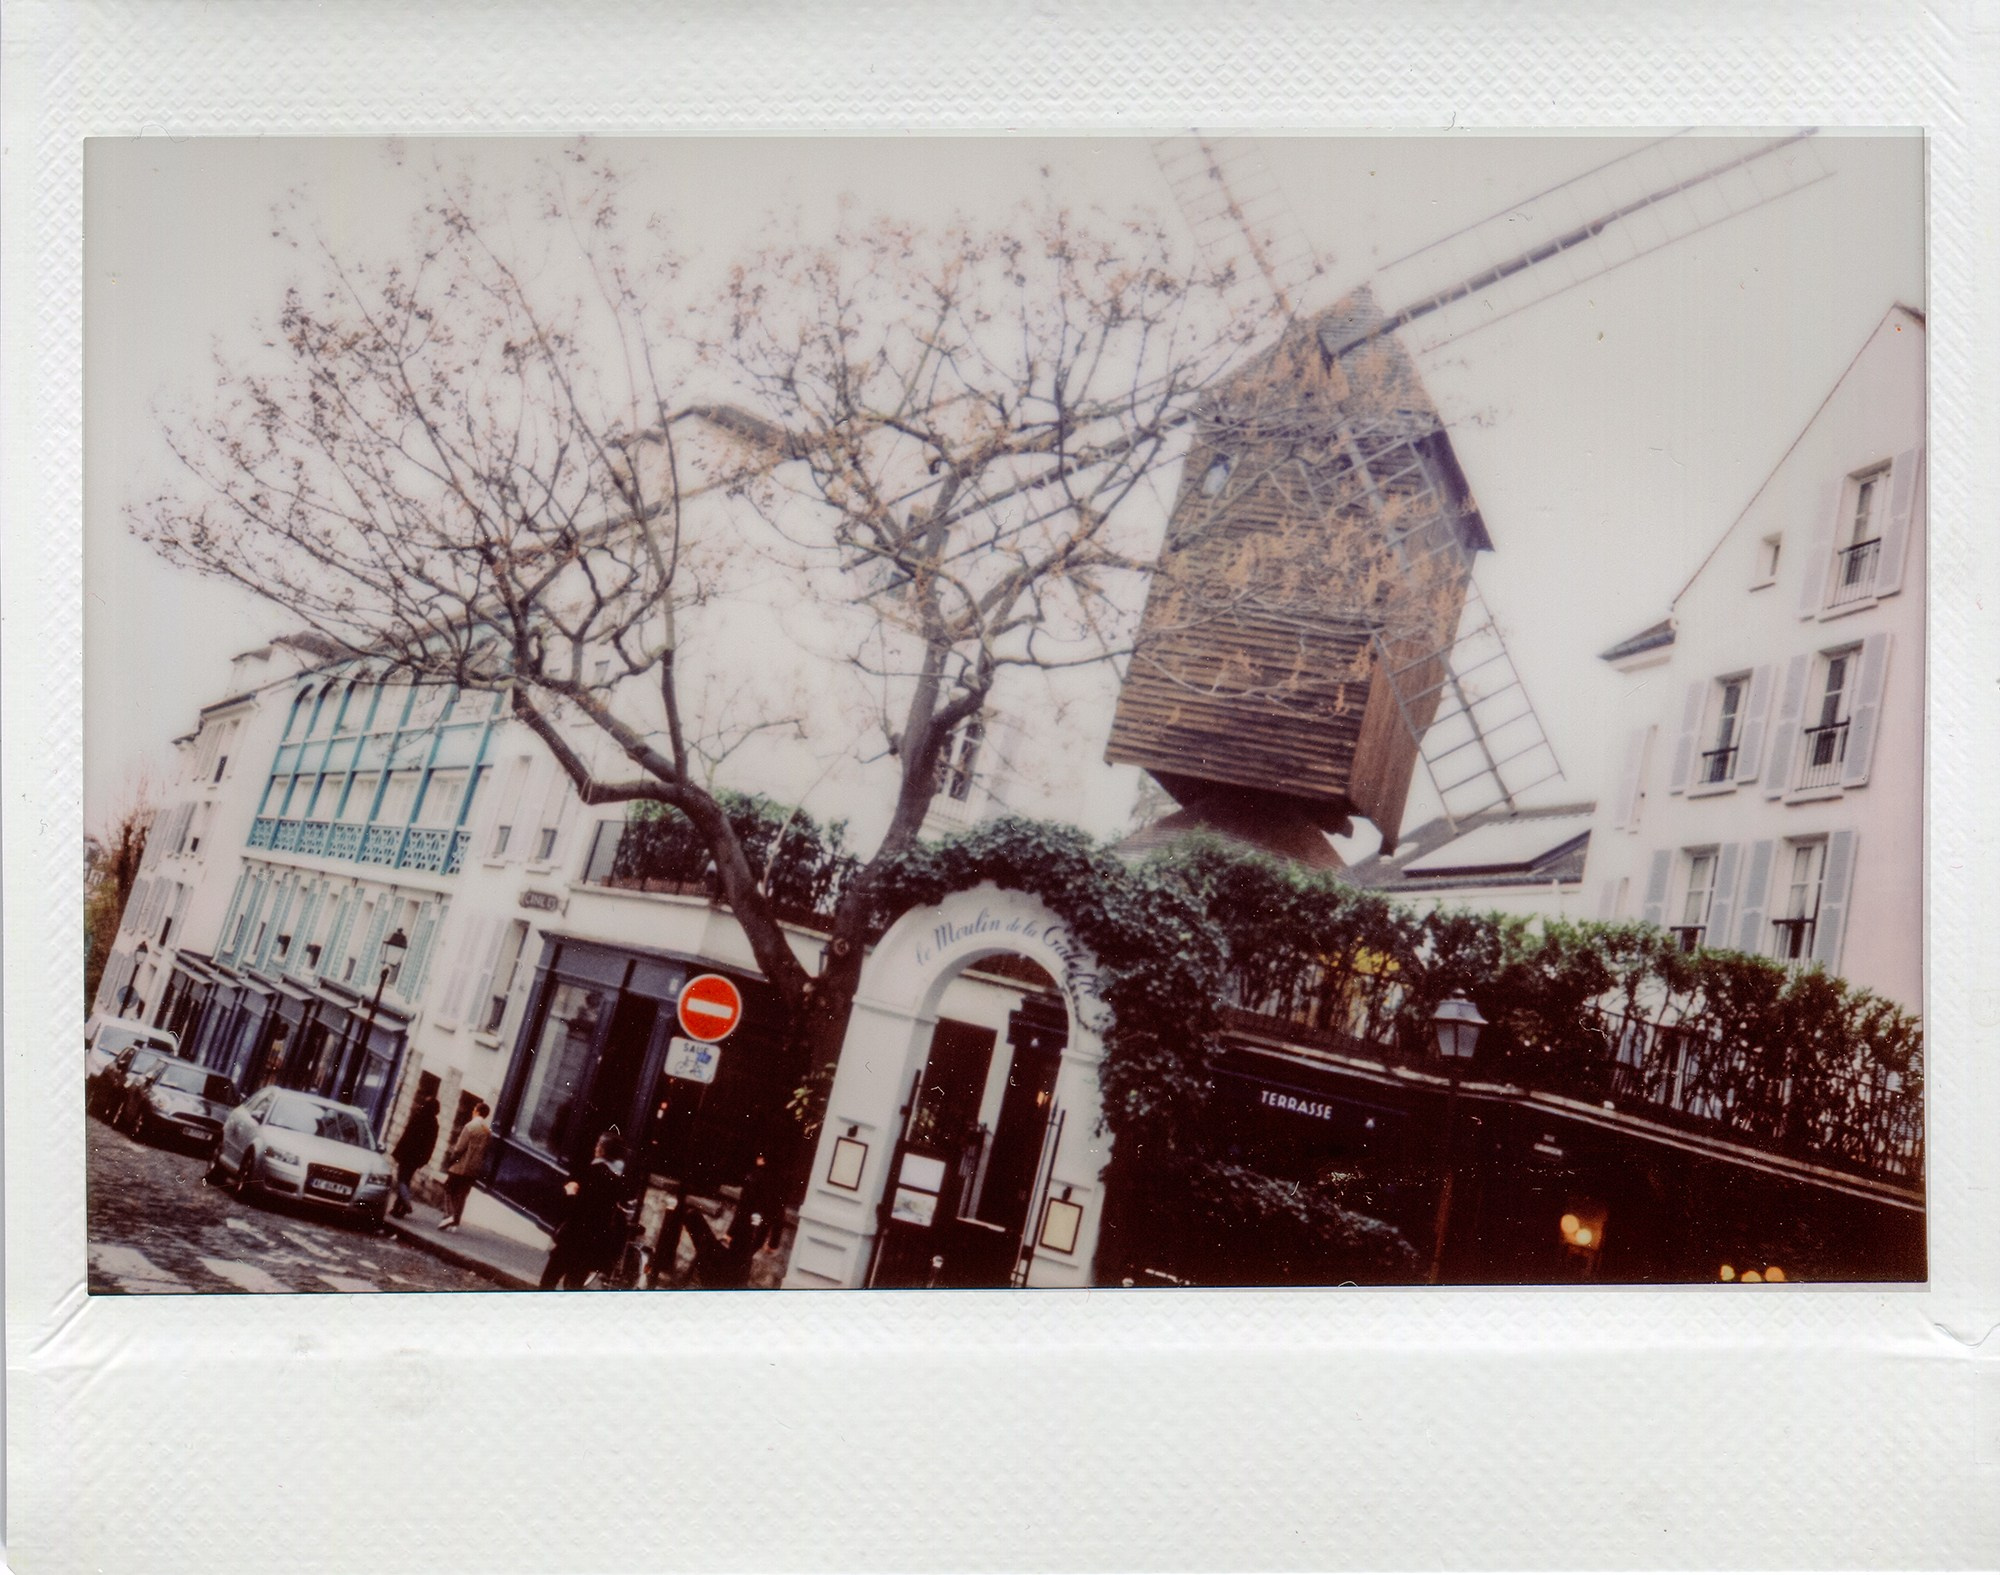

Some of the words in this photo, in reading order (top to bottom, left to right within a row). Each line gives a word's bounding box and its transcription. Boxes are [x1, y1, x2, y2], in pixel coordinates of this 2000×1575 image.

[933, 907, 1001, 952] Moulin
[1006, 917, 1021, 933] de
[1022, 920, 1038, 938] la
[1261, 1090, 1333, 1120] TERRASSE
